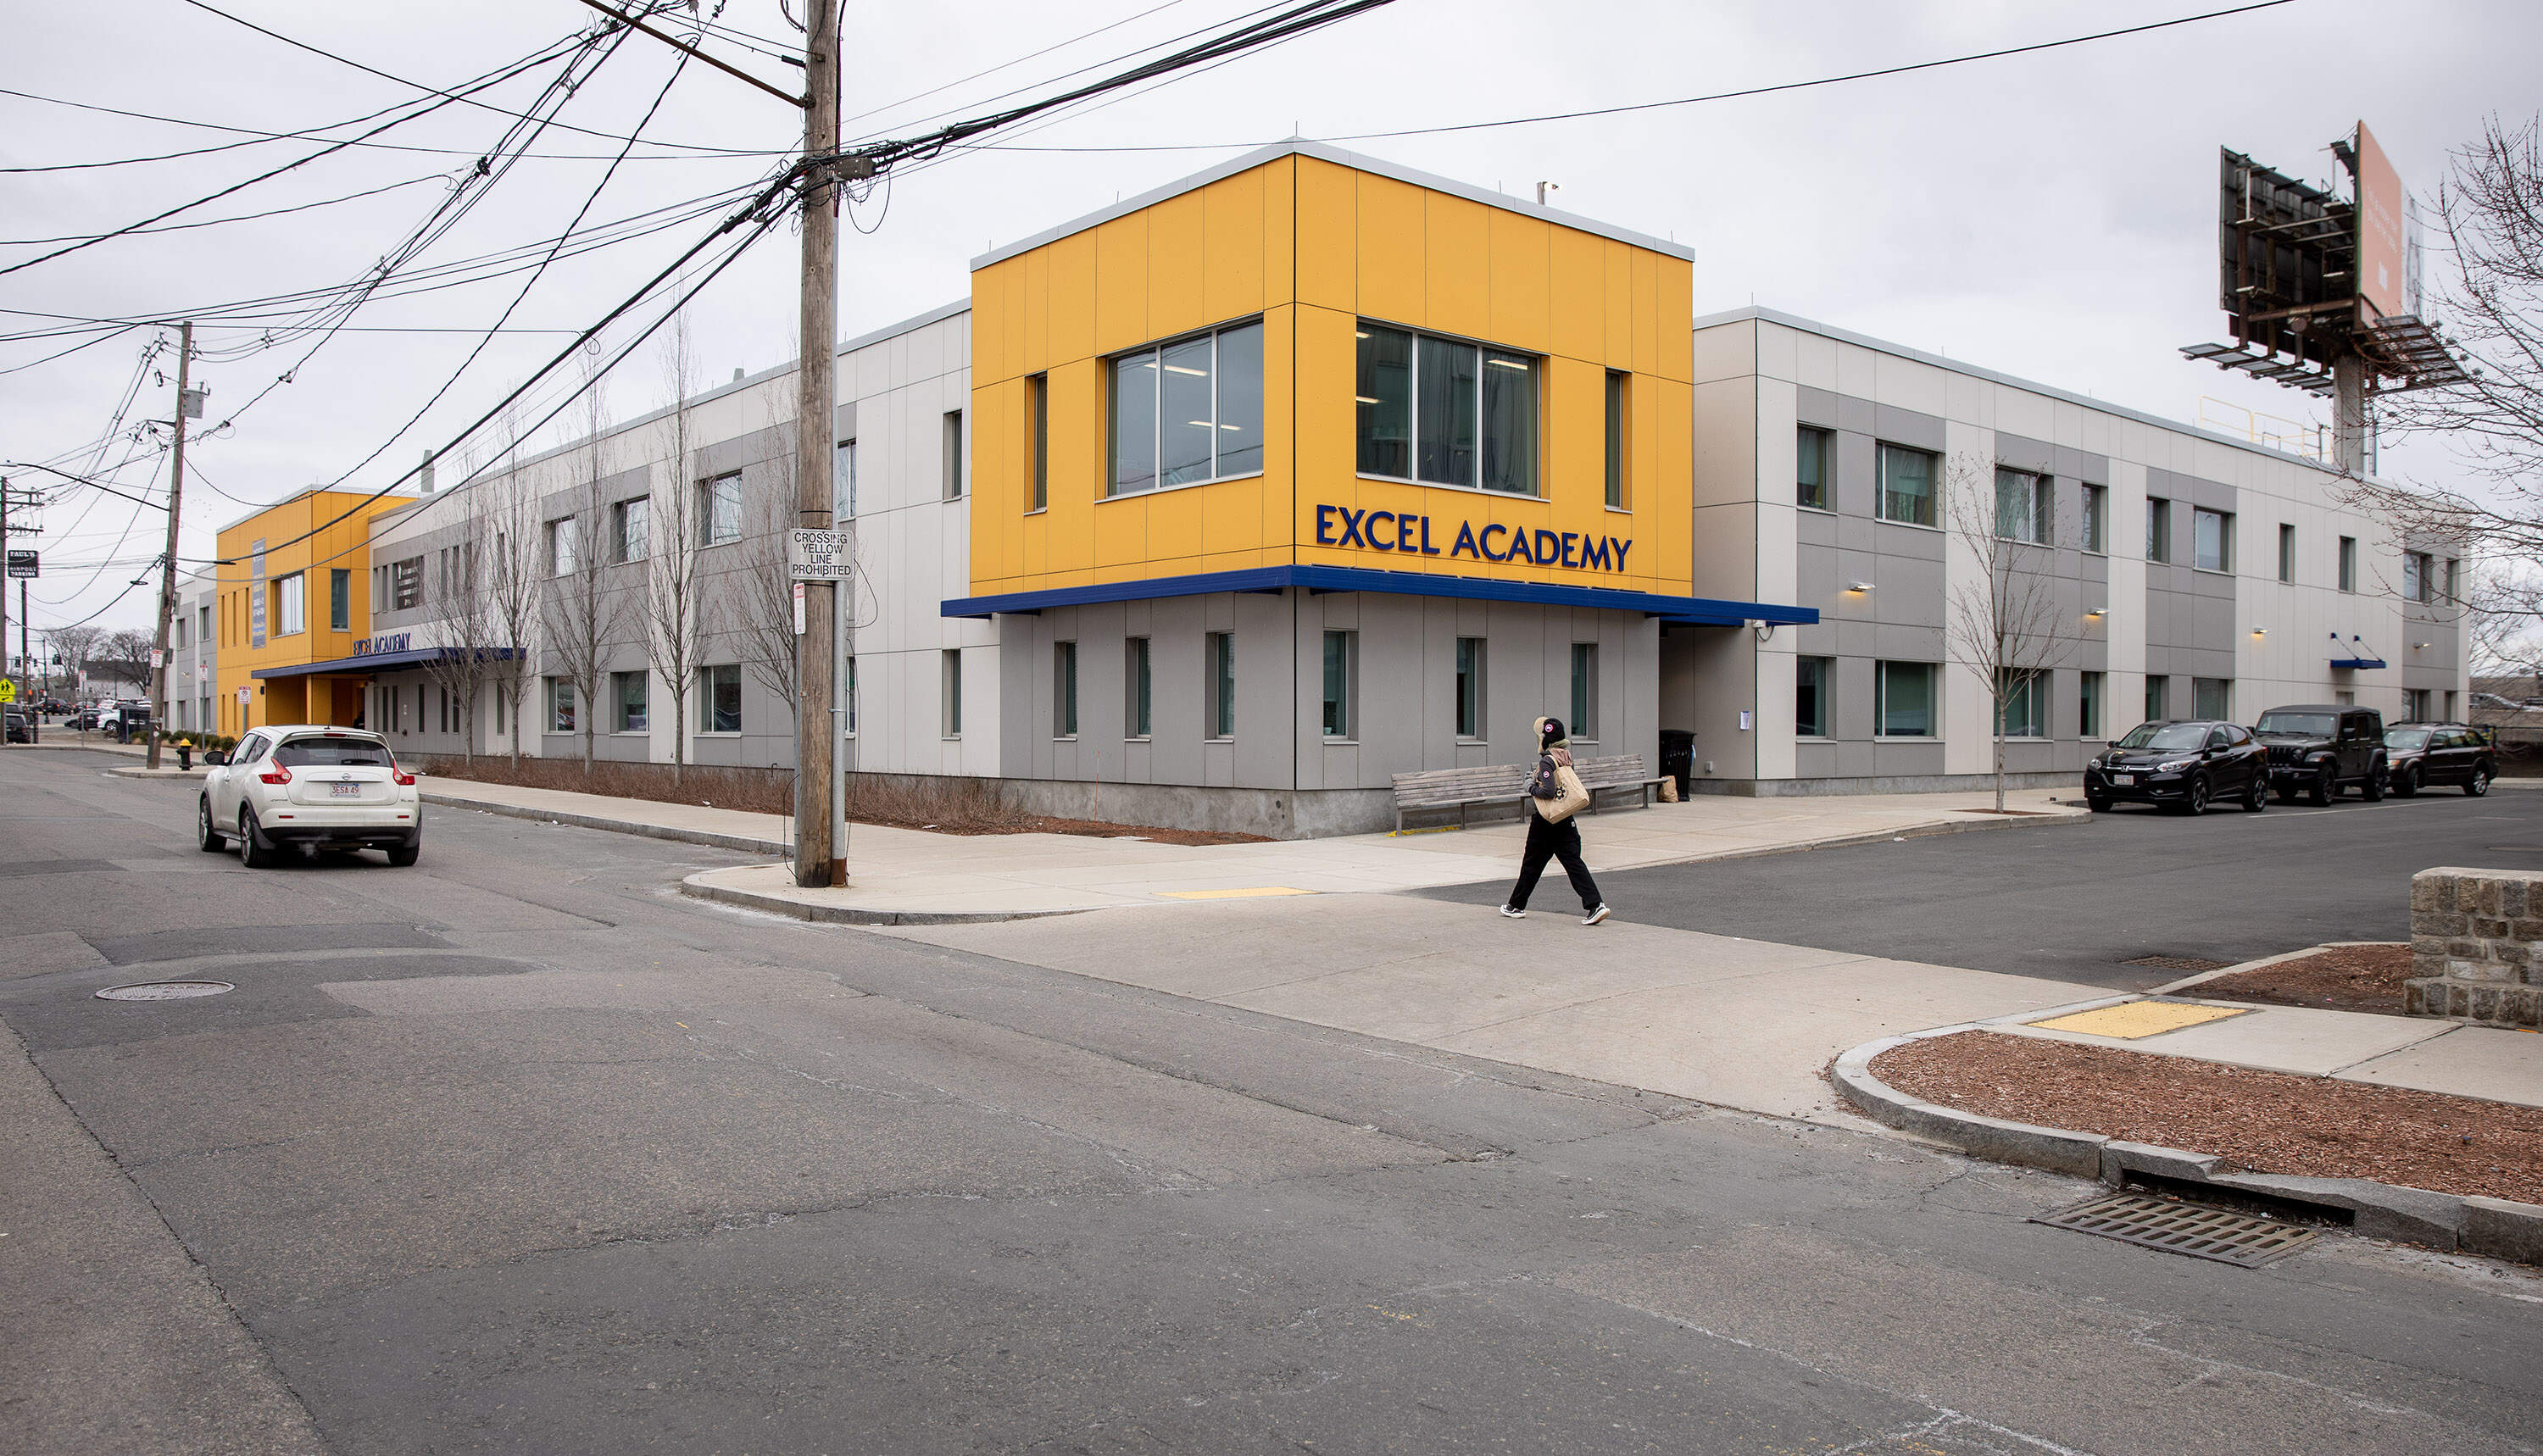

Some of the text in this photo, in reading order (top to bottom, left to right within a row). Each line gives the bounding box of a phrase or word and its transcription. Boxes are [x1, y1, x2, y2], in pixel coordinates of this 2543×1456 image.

[794, 532, 848, 544] CROSSING
[1316, 504, 1633, 572] EXCEL ACADEMY
[802, 544, 843, 554] YELLOW
[810, 554, 832, 564] LINE
[793, 564, 851, 575] PROHIBITED
[353, 632, 410, 655] EXCEL ACADEMY
[331, 786, 359, 794] 3ESA 49
